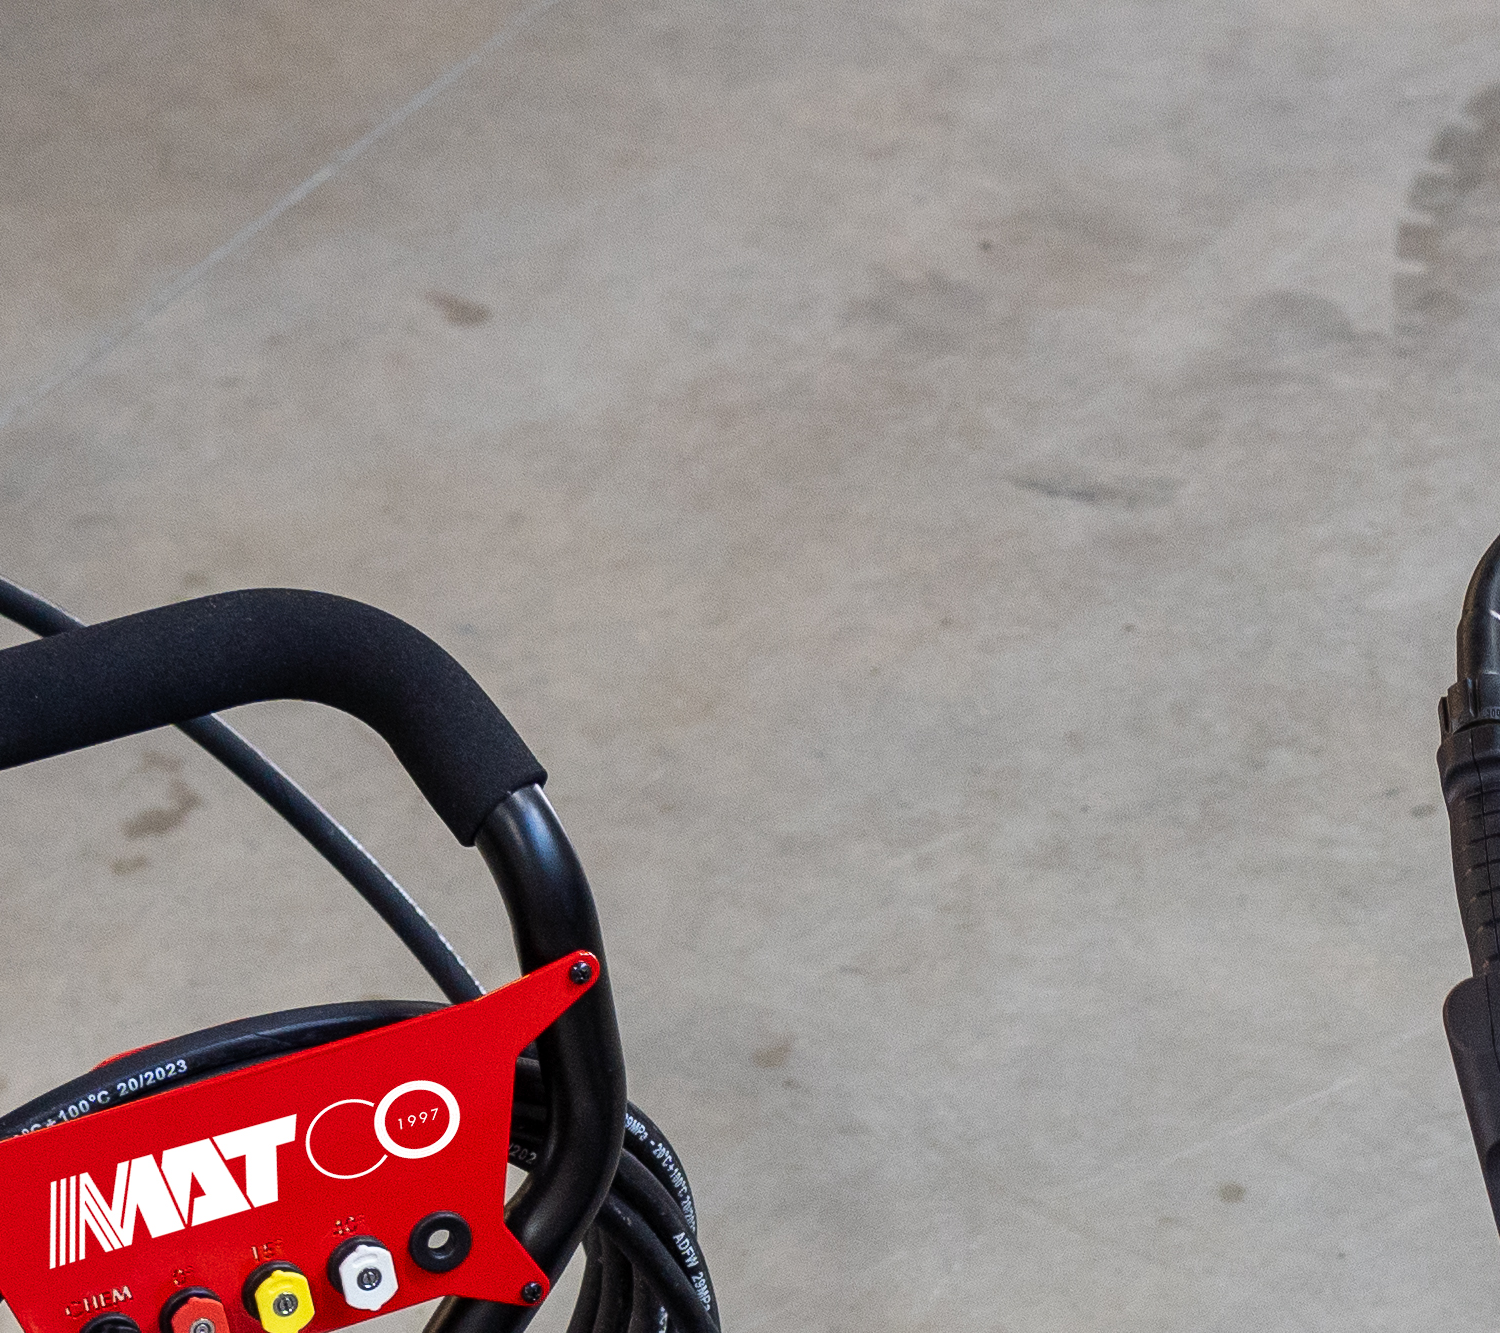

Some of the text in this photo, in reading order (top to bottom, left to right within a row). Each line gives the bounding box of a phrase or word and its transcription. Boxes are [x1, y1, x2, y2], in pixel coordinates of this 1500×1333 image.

[116, 1059, 189, 1097] 20/2023
[395, 1106, 441, 1132] 1997
[623, 1113, 649, 1142] 9MPa
[672, 1231, 700, 1269] ADFW
[64, 1284, 133, 1320] CHEM
